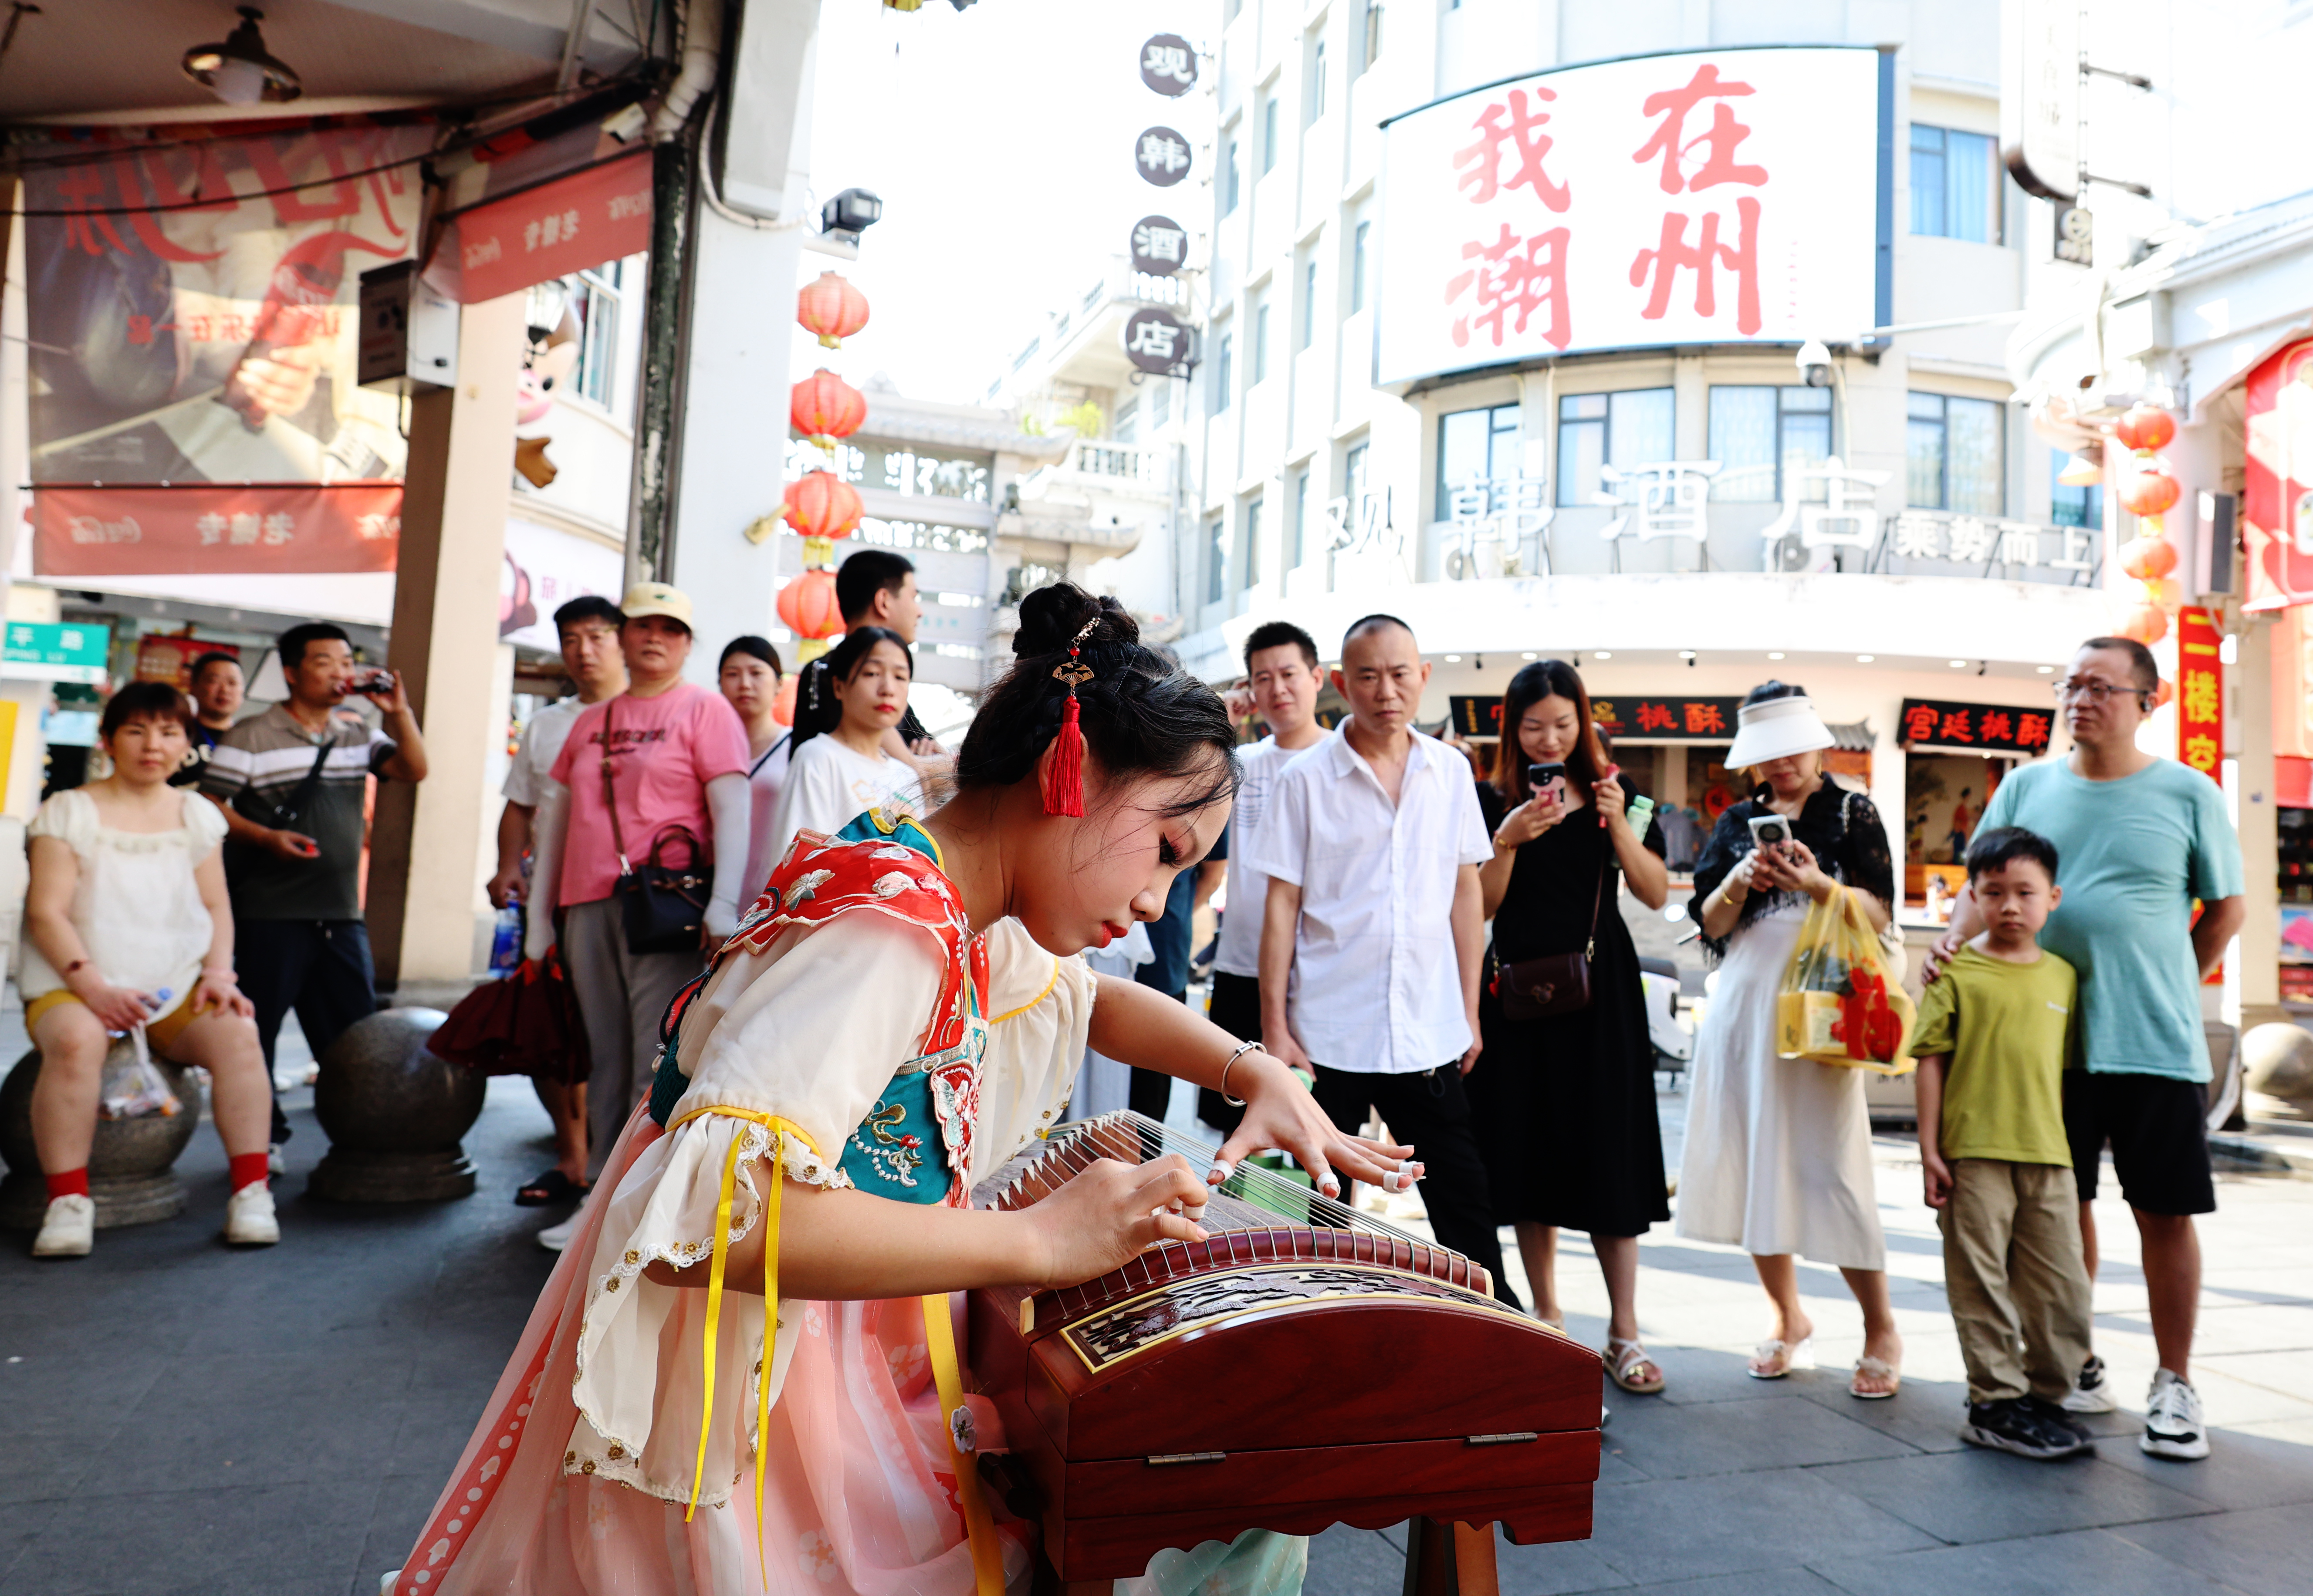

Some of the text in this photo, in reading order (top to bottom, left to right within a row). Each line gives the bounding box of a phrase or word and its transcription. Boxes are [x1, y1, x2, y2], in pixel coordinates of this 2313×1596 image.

[1128, 44, 1194, 358] 观韩酒店
[1326, 456, 1893, 556] 观韩酒店
[1895, 511, 2093, 571] 乘势而上
[1636, 702, 1726, 735] 桃酥
[1904, 704, 2050, 747] 宫廷桃酥
